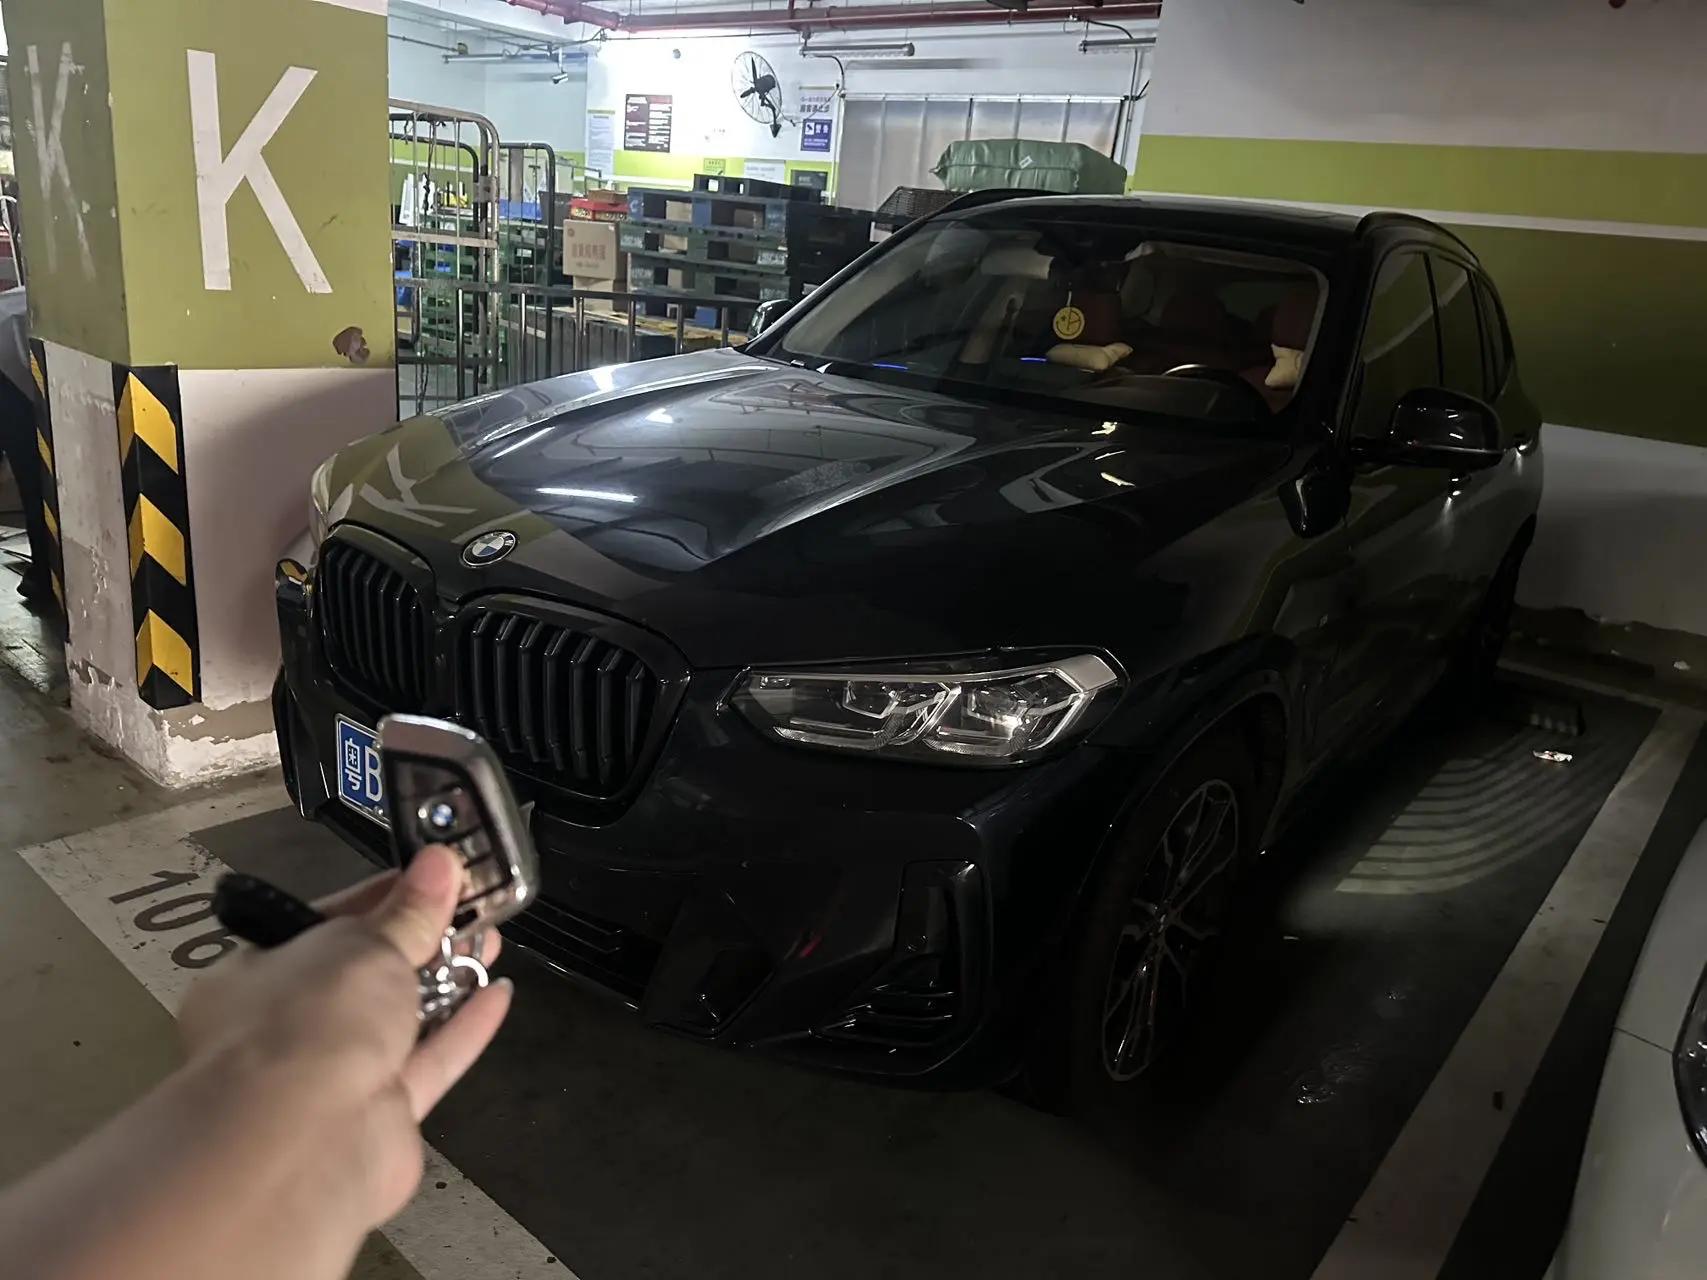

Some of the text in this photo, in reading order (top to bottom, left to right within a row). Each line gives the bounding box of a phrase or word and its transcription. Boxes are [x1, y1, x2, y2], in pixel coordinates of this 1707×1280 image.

[26, 41, 96, 281] K
[186, 49, 333, 294] K
[108, 870, 238, 969] 106
